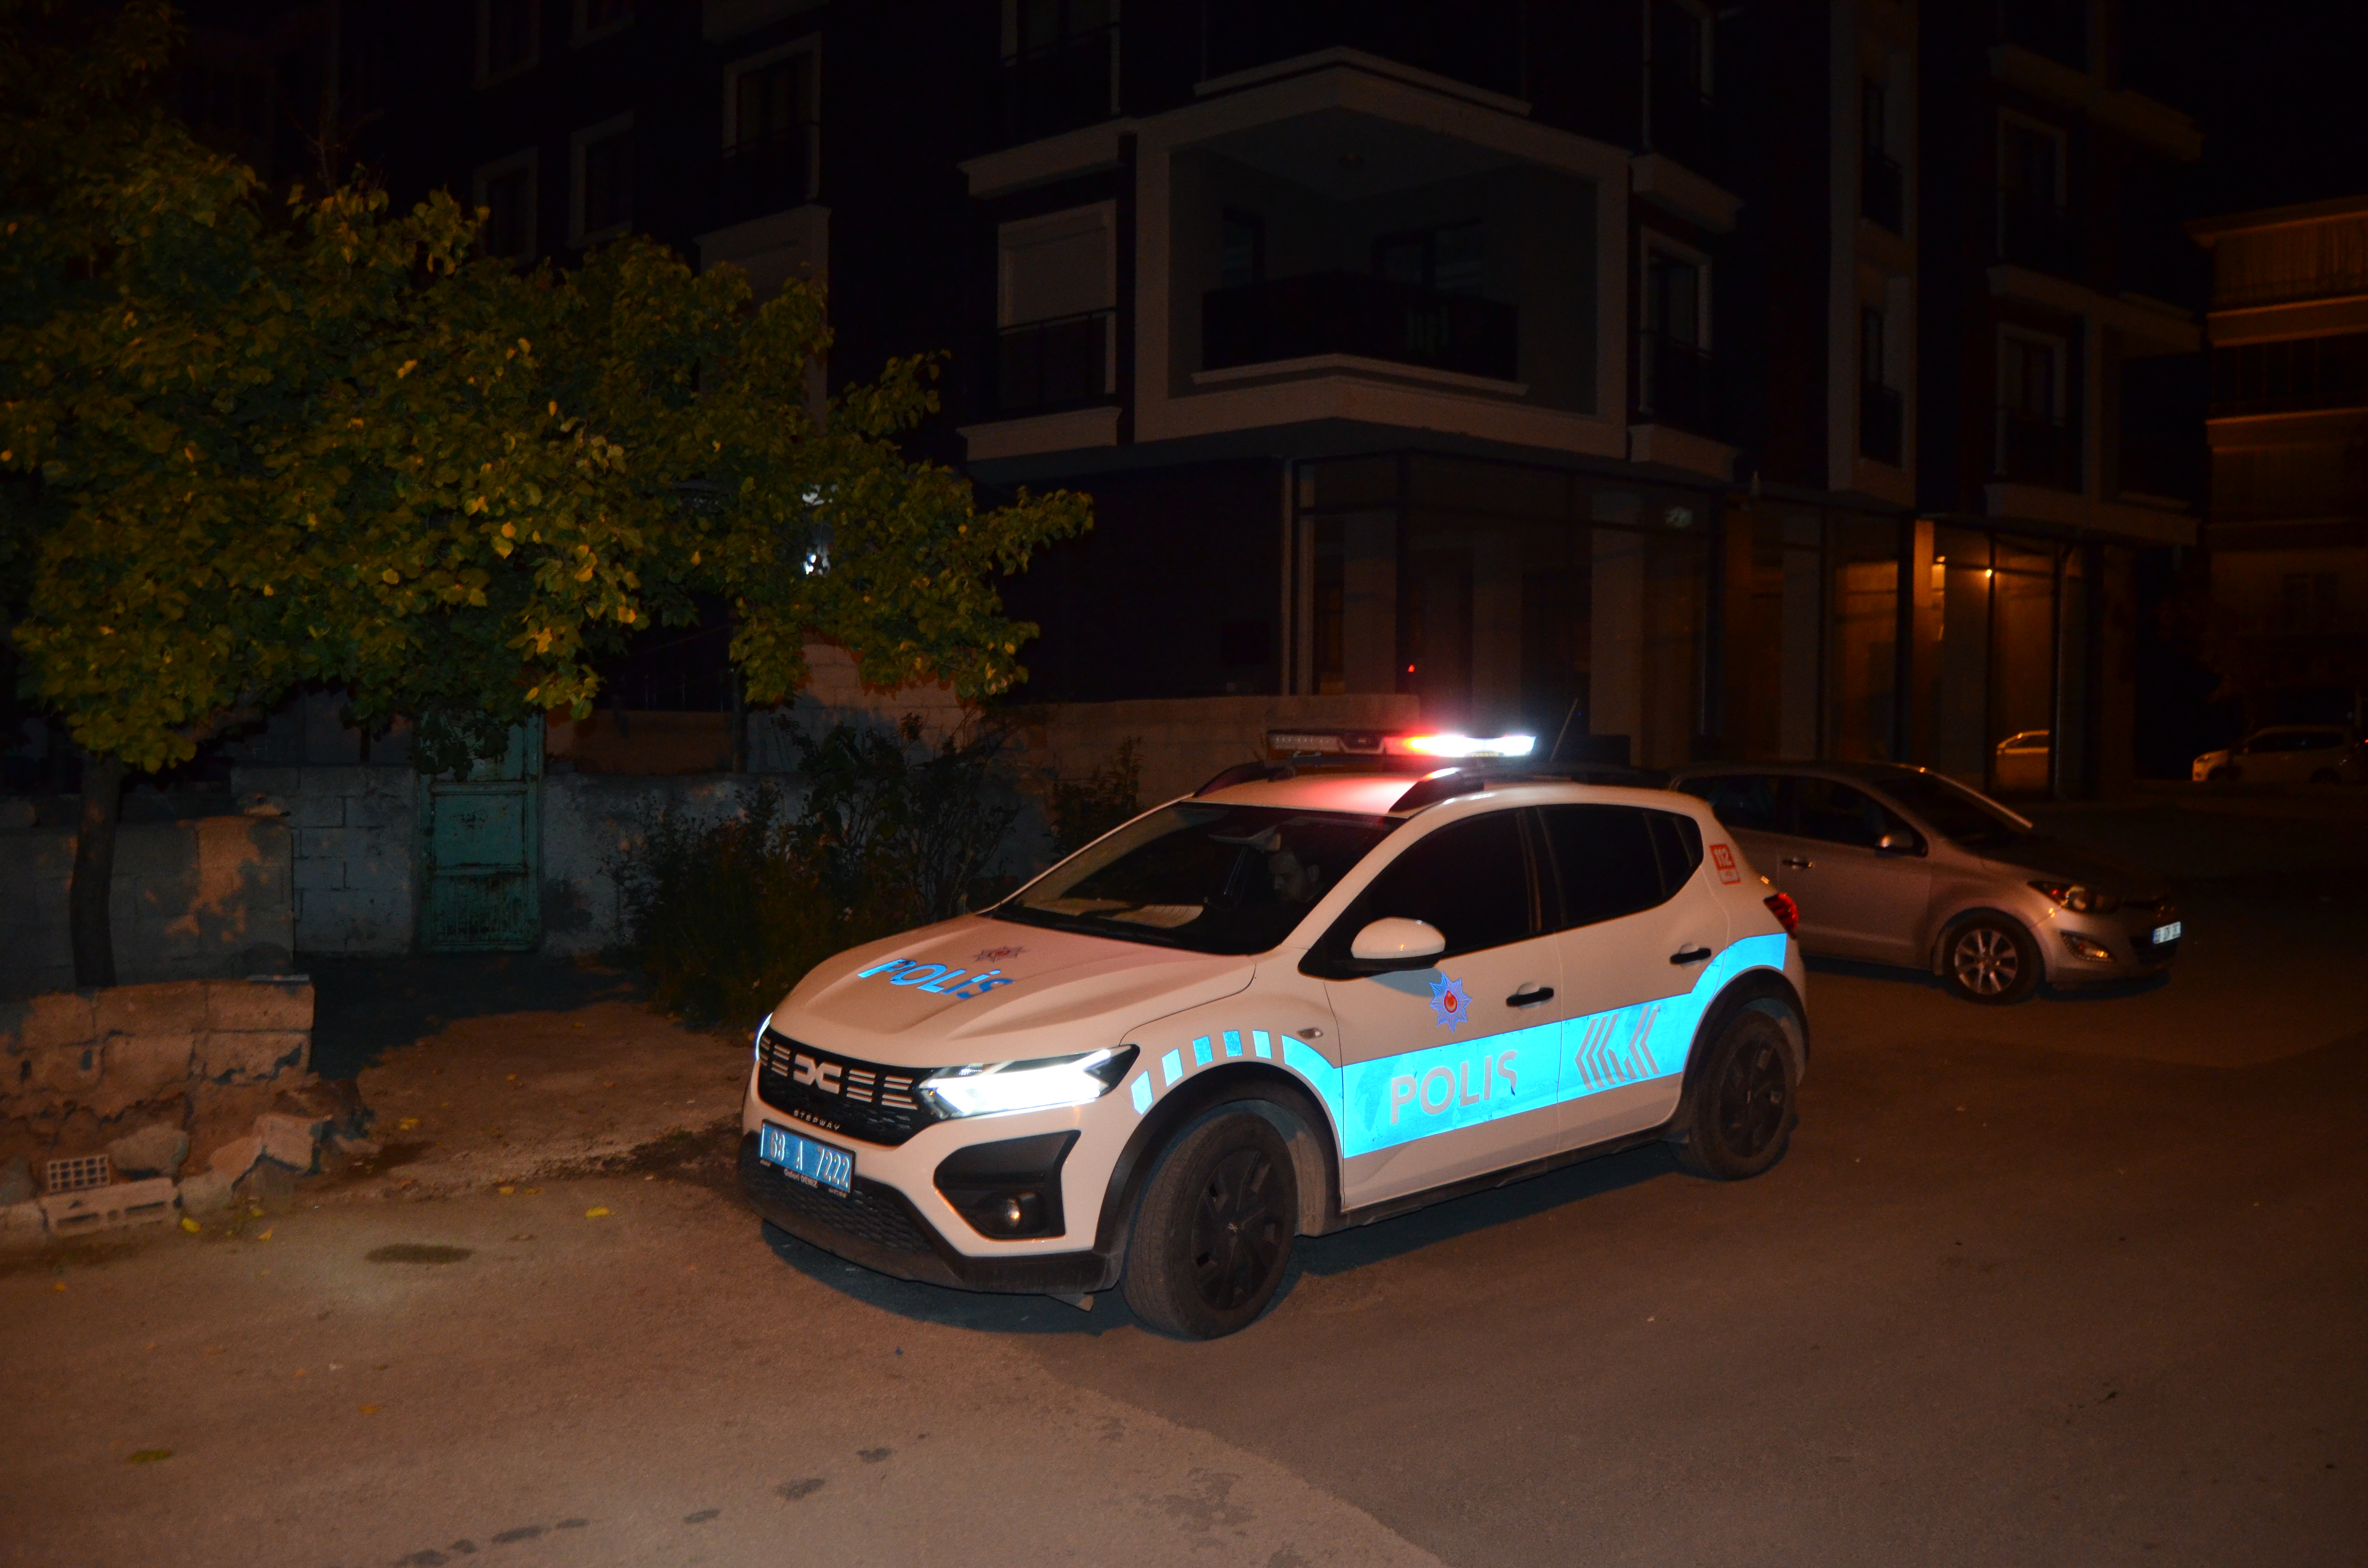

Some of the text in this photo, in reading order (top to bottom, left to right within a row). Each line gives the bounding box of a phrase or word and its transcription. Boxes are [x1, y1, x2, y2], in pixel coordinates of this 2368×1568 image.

[1714, 848, 1732, 867] 112
[793, 1109, 840, 1131] STEPWAY
[770, 1130, 850, 1188] 68 A 7222
